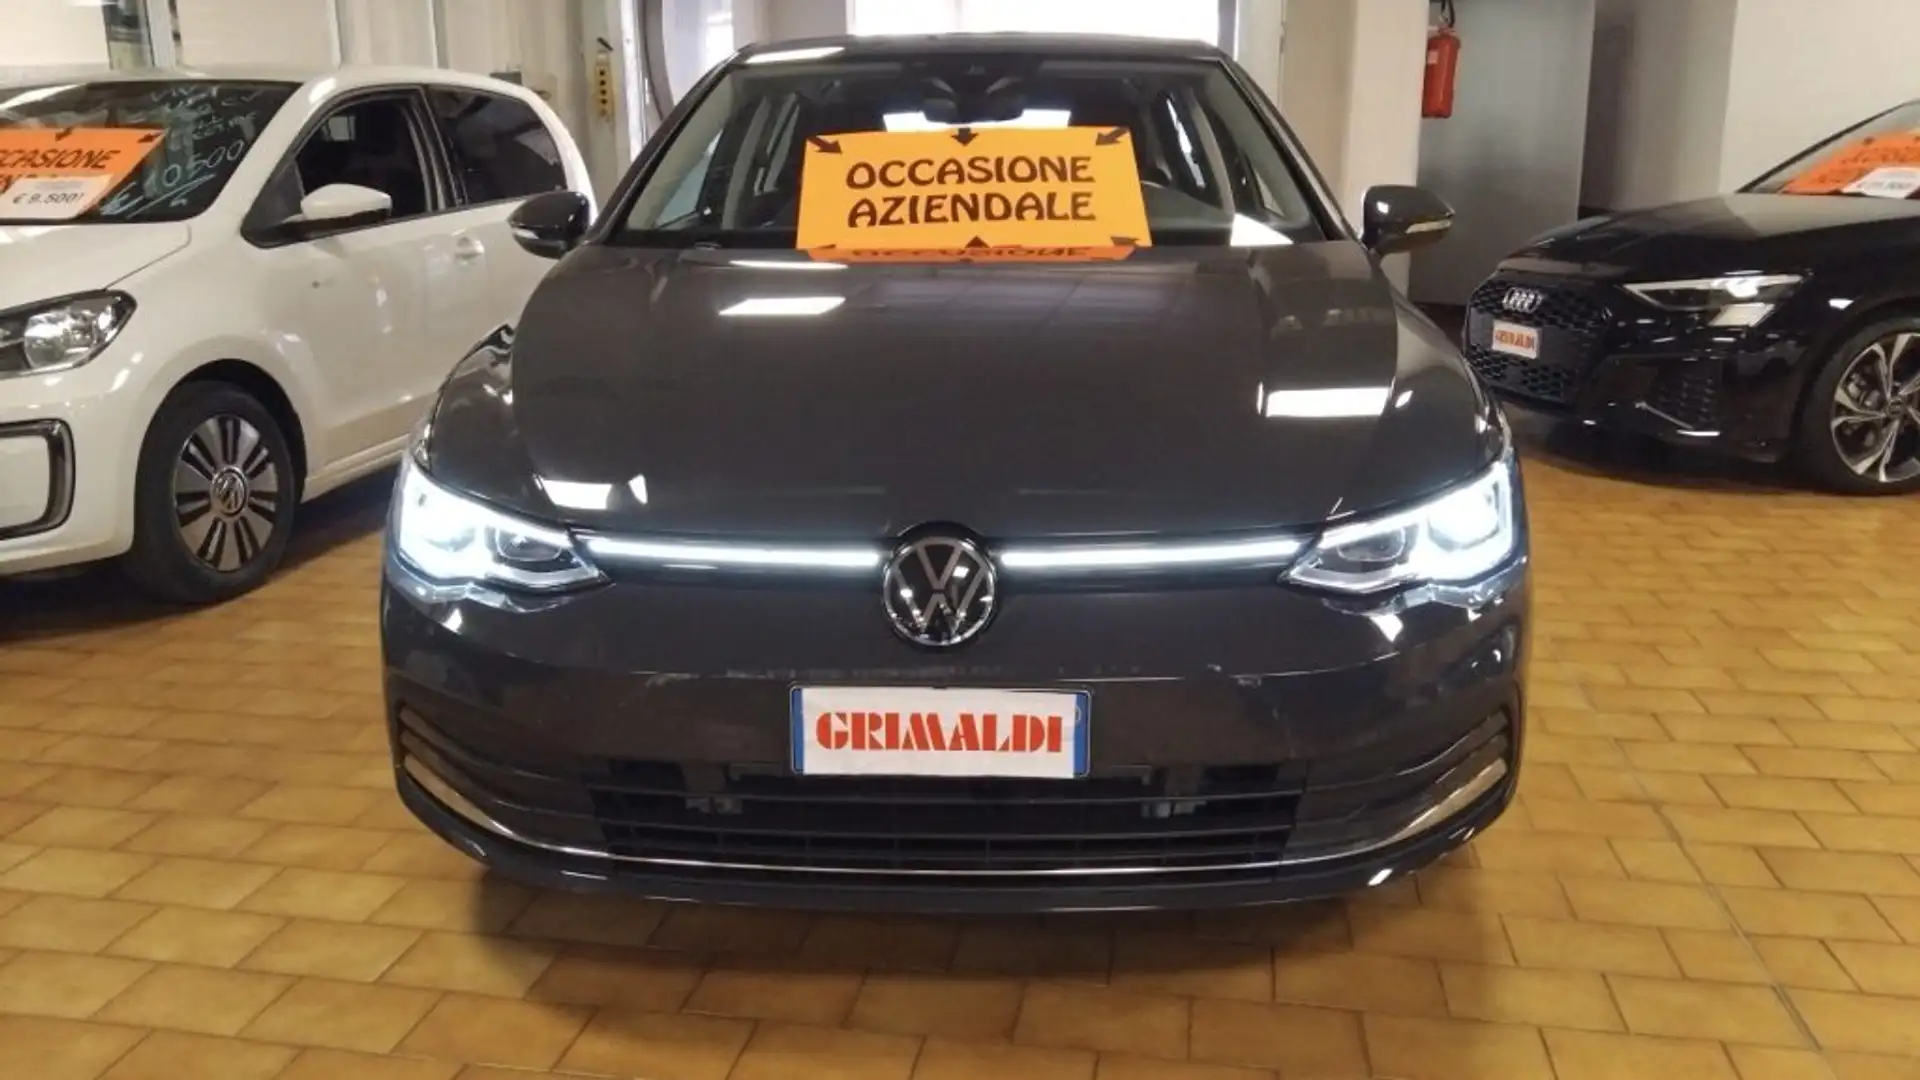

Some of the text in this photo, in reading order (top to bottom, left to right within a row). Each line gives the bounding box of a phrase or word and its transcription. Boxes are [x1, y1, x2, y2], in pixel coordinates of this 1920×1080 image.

[846, 155, 1096, 189] OCCASIONE
[847, 192, 1096, 228] AZIENDALE
[815, 712, 1062, 753] GRIMALDI
